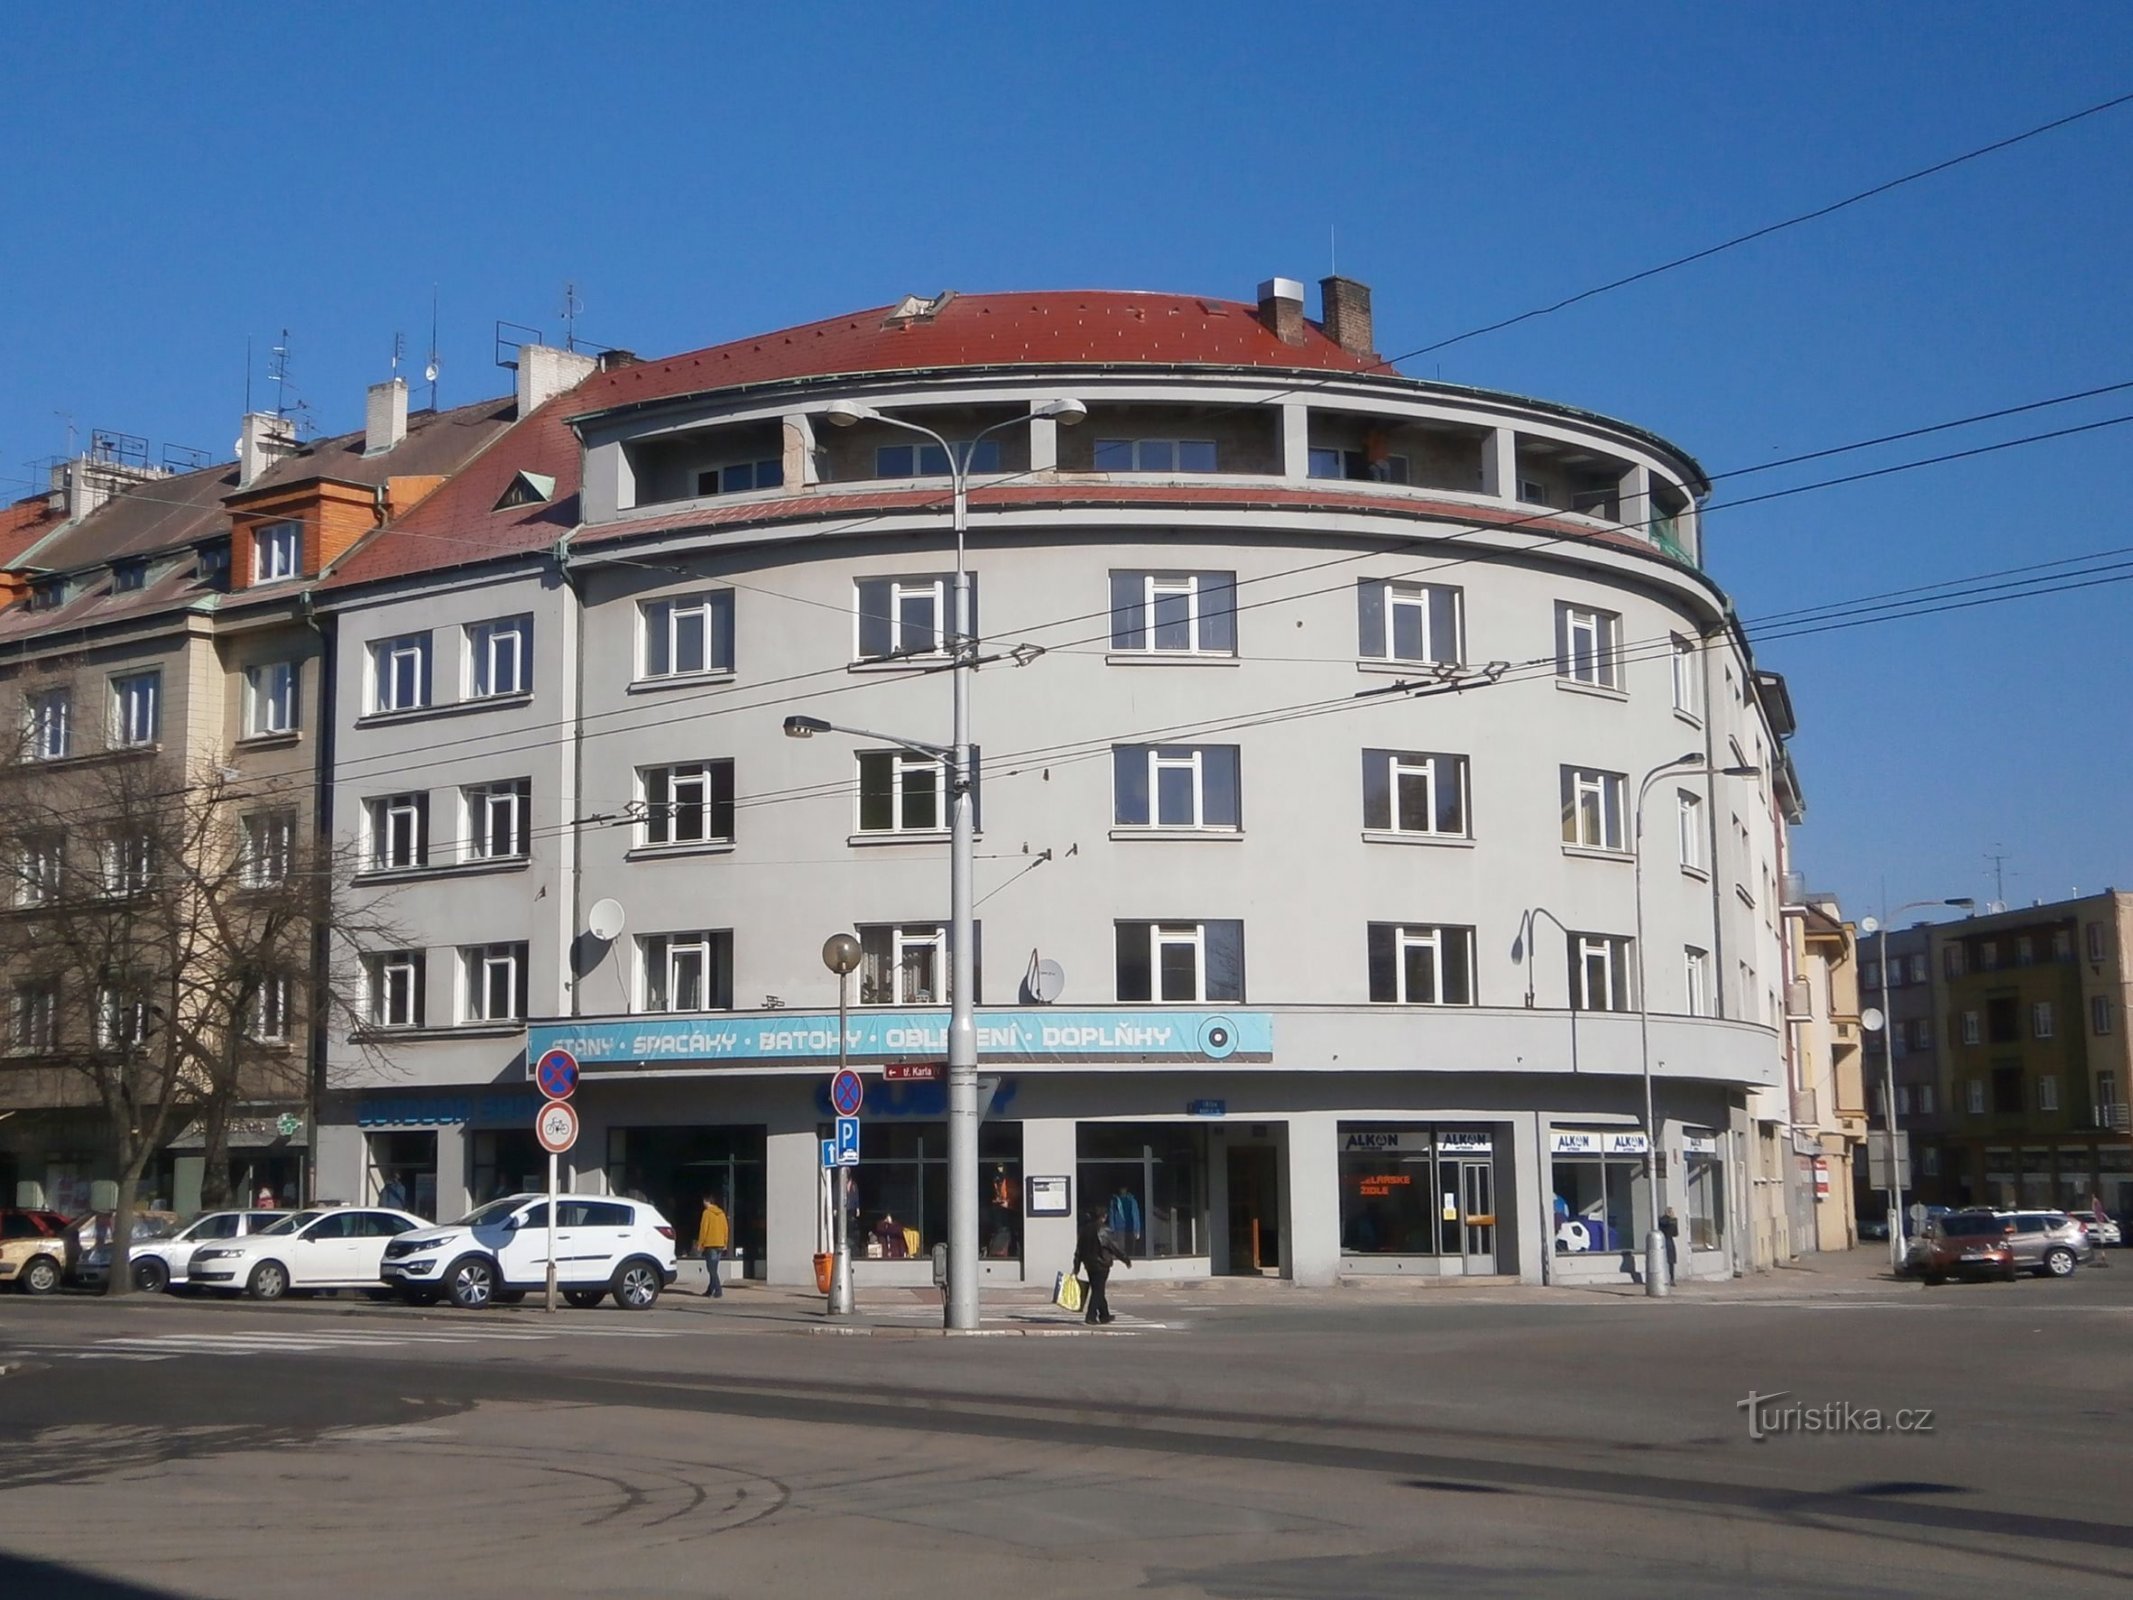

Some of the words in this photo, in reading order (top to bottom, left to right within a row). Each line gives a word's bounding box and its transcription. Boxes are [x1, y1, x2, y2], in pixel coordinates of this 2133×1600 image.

[912, 1065, 932, 1077] Karla
[843, 1123, 853, 1148] P
[1346, 1134, 1398, 1150] ALKON
[1443, 1134, 1486, 1149] ALKON
[1558, 1135, 1590, 1151] ALKON
[1614, 1136, 1644, 1152] ALKON
